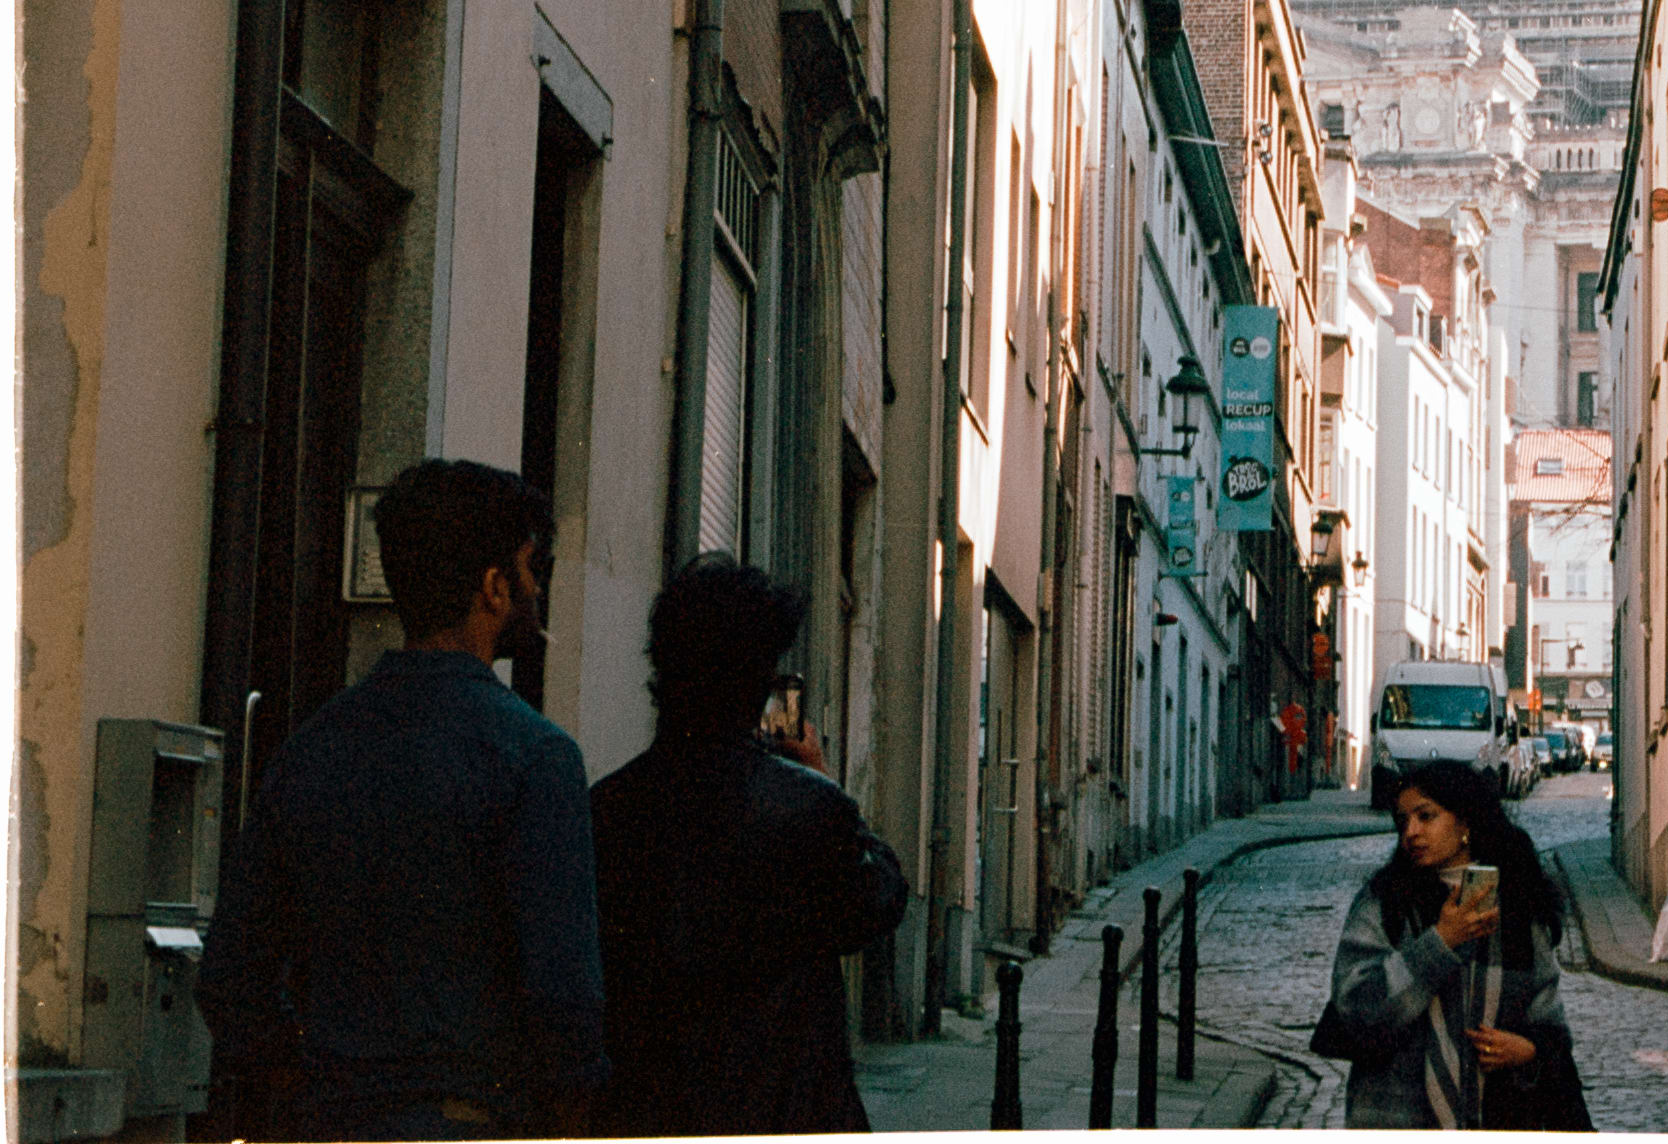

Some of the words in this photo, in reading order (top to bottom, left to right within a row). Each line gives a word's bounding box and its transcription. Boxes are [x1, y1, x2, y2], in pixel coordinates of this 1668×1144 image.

[1226, 387, 1260, 401] local
[1226, 404, 1272, 417] RECUP
[1225, 418, 1266, 432] lokaal
[1228, 470, 1268, 498] BROL
